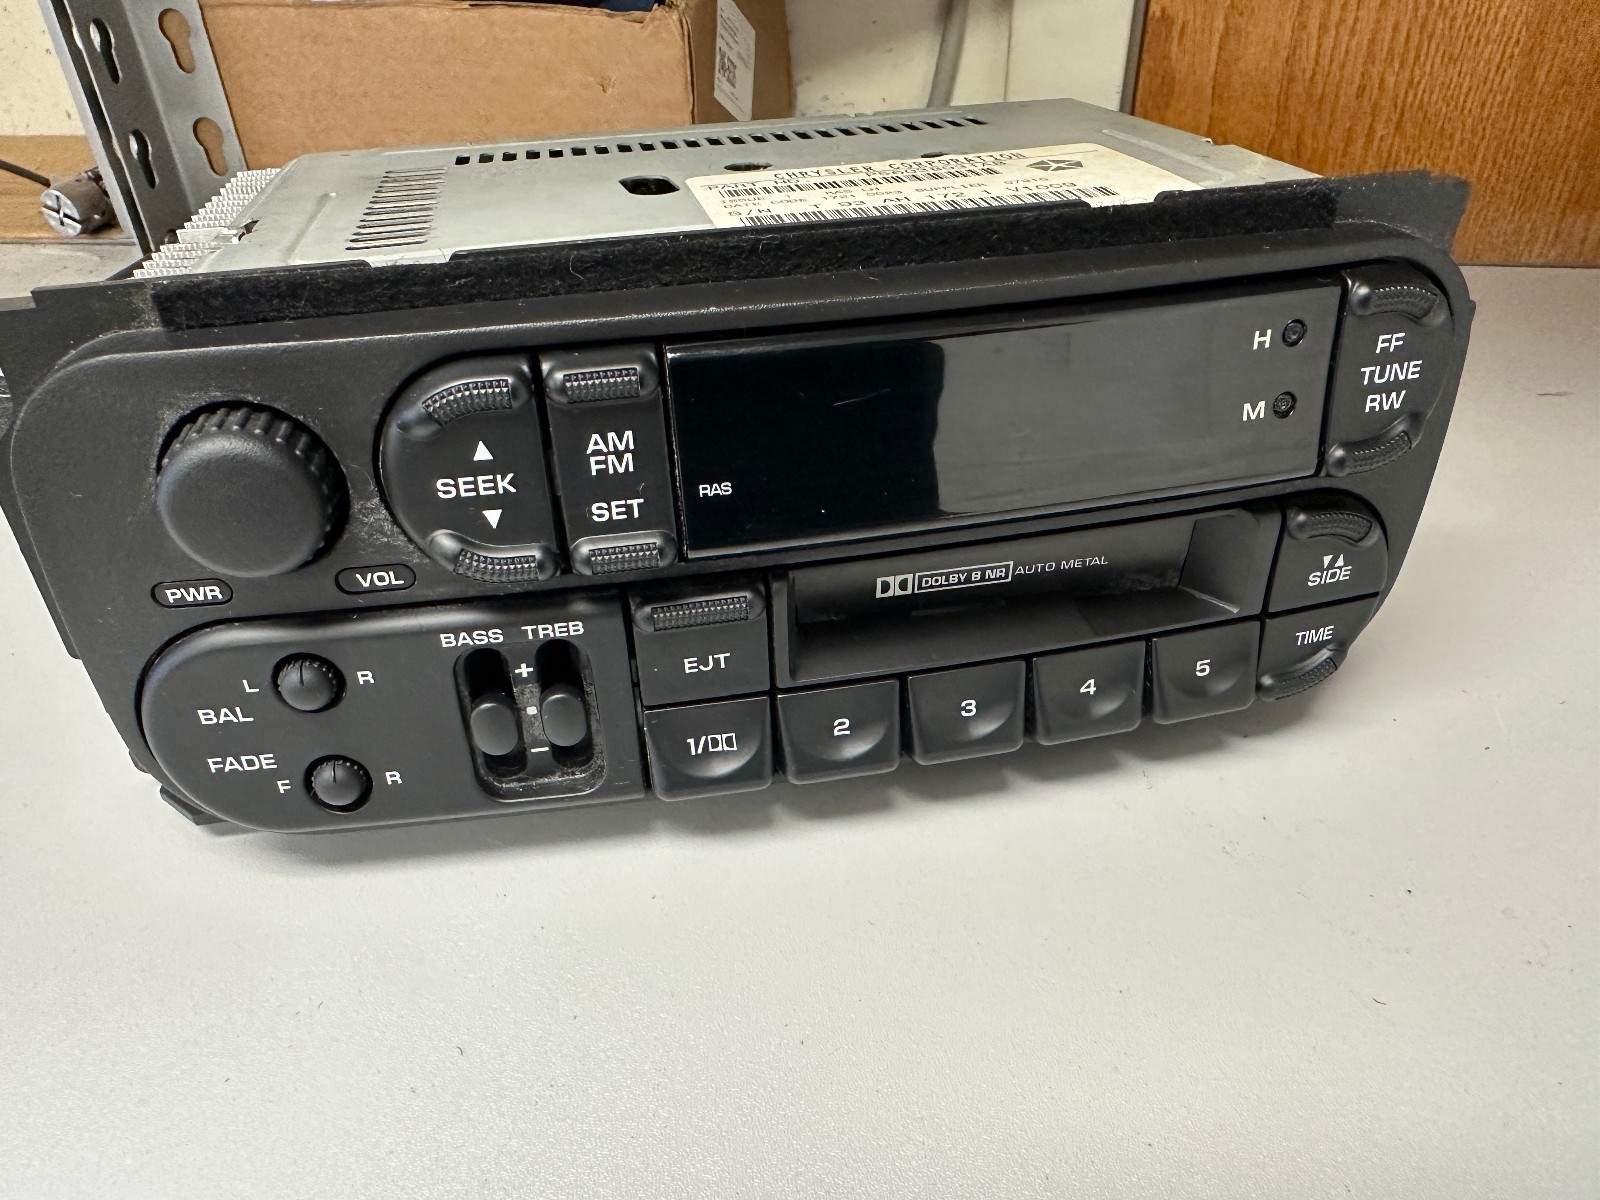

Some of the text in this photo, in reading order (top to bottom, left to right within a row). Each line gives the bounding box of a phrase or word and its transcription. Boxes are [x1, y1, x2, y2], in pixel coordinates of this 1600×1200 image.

[774, 152, 1027, 180] CHRYSLER CORPORATION
[708, 182, 757, 190] PART
[1252, 328, 1272, 350] H
[1375, 332, 1406, 354] FF
[1360, 359, 1423, 386] TUNE
[1242, 400, 1266, 422] M
[1364, 389, 1407, 413] RW
[586, 430, 635, 454] AM
[590, 453, 634, 476] FM
[435, 472, 517, 499] SEEK
[698, 481, 733, 498] RAS
[591, 498, 645, 522] SET
[355, 570, 405, 588] VOL
[921, 573, 967, 588] DOLBY
[971, 570, 982, 582] B
[985, 567, 1006, 580] NR
[1014, 562, 1055, 576] AUTO
[1060, 555, 1109, 570] METAL
[1307, 566, 1353, 587] SIDE
[164, 585, 223, 604] PWR
[439, 620, 585, 648] BASS TREB
[1295, 625, 1335, 646] TIME
[683, 652, 731, 674] EJT
[1195, 659, 1211, 677] 5
[242, 679, 260, 693] L
[356, 670, 375, 685] R
[1079, 678, 1097, 695] 4
[197, 706, 255, 725] BAL
[960, 699, 977, 717] 3
[833, 718, 851, 737] 2
[206, 753, 278, 774] FADE
[276, 779, 292, 794] F
[384, 770, 403, 786] R
